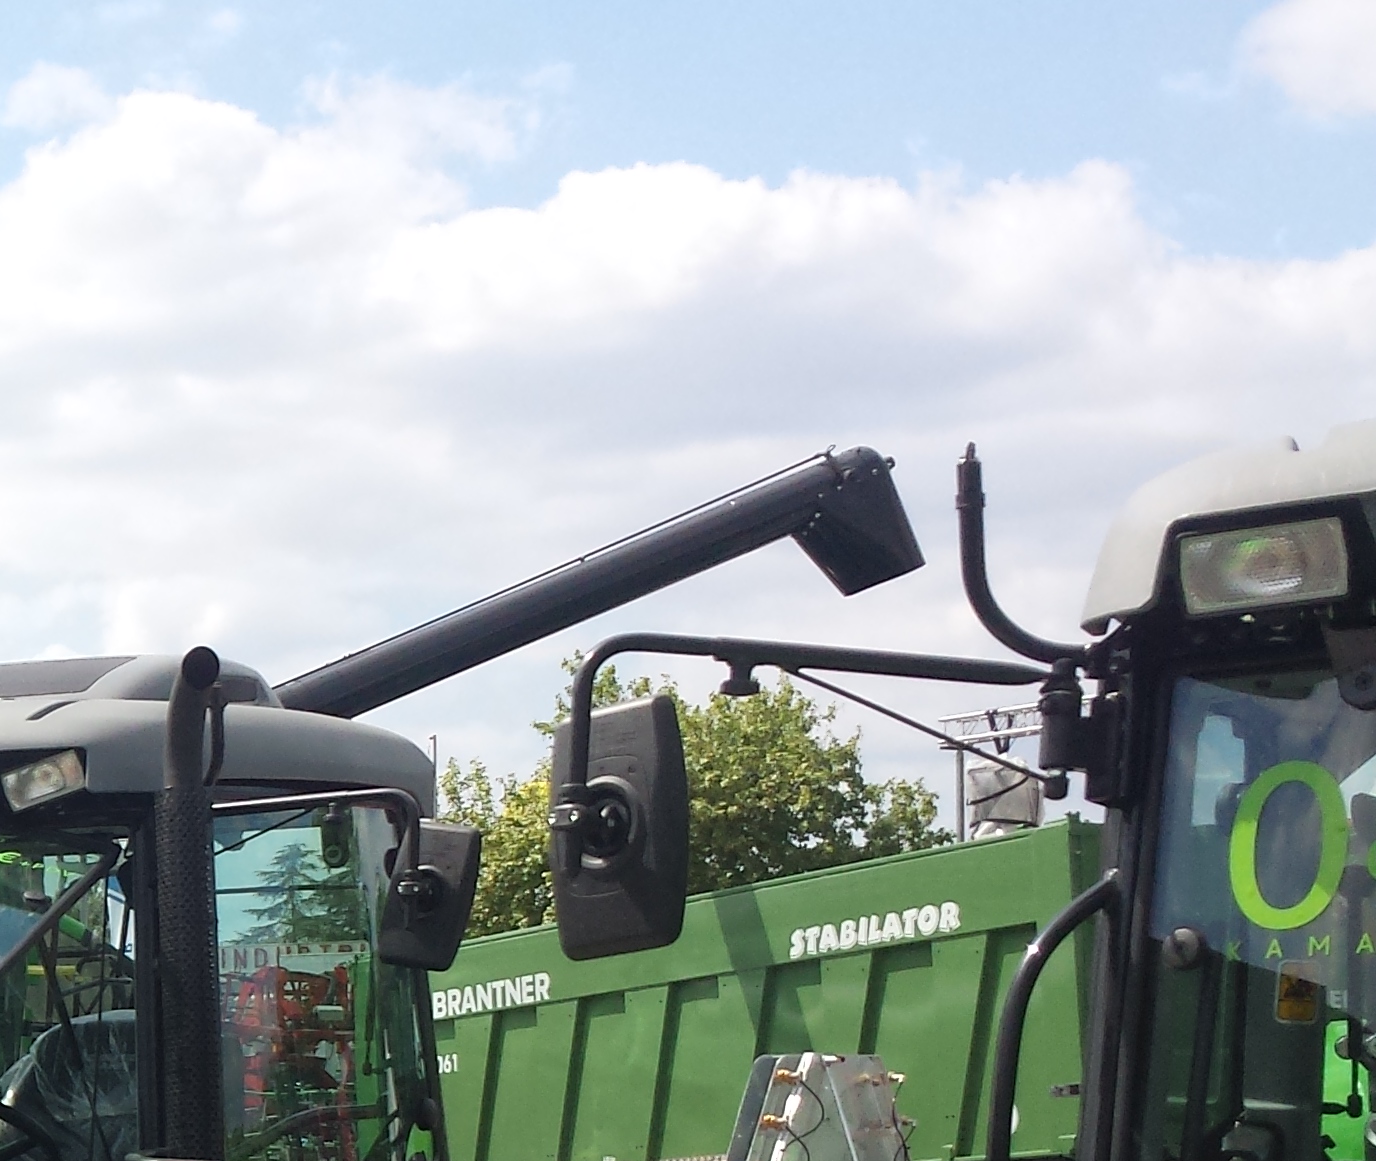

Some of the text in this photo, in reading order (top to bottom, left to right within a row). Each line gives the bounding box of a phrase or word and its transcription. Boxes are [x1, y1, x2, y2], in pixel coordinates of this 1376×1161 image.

[1228, 759, 1376, 931] 0
[789, 901, 961, 960] STABILATOR
[432, 972, 552, 1020] BRANTNER
